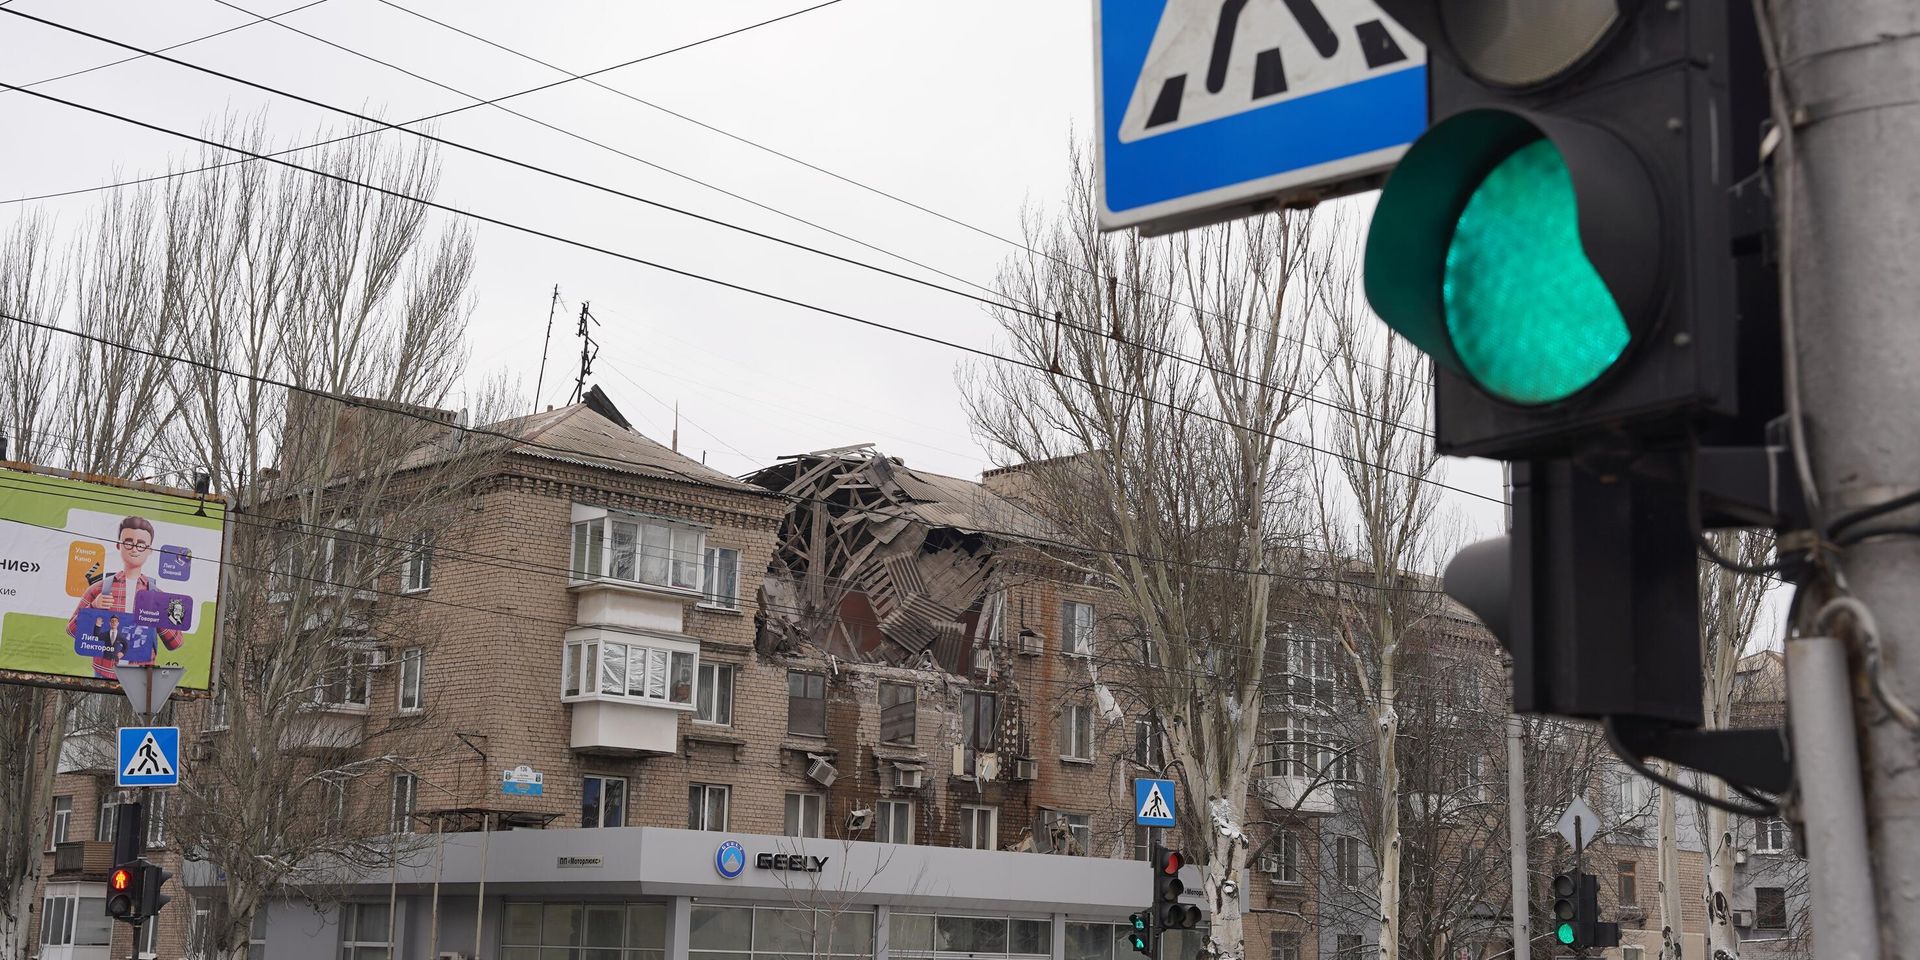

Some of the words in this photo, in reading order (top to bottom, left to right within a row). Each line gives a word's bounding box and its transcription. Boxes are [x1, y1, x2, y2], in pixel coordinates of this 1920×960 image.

[81, 633, 99, 642] Лига
[80, 642, 115, 653] Лекторов
[755, 852, 829, 873] GEELY
